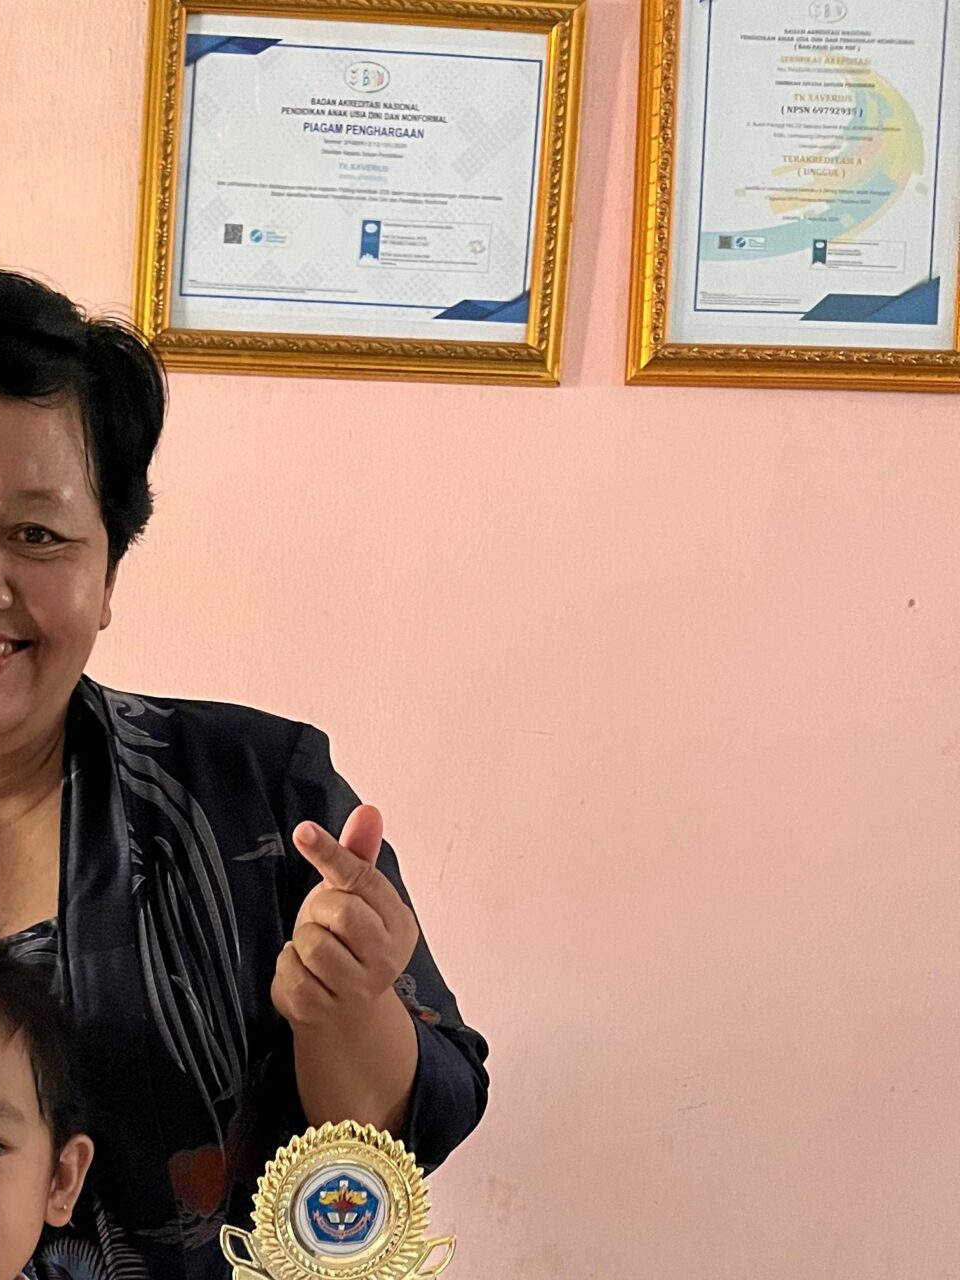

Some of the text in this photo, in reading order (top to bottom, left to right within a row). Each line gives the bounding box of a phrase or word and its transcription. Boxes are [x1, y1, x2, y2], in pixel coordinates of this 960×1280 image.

[311, 98, 420, 111] BADAN AKREDITASI NASIONAL
[787, 106, 811, 114] NPSN
[281, 107, 448, 123] PENDIDIKAN ANAK USIA DINI DAN NONFORMAL
[304, 122, 425, 138] PIAGAM PENGHARGAAN
